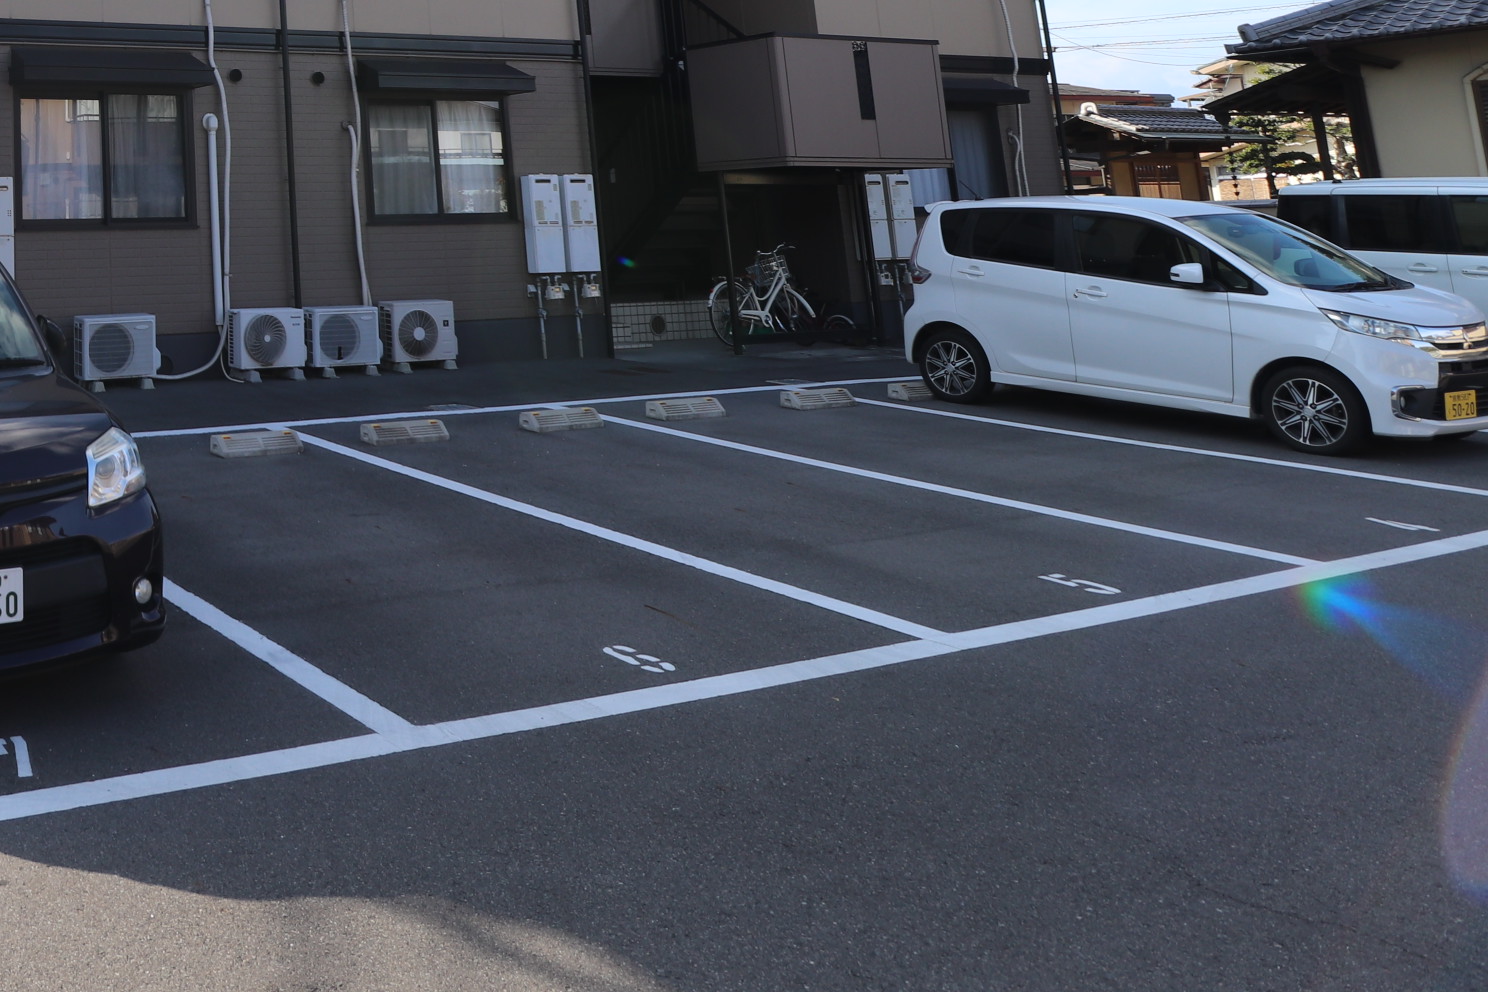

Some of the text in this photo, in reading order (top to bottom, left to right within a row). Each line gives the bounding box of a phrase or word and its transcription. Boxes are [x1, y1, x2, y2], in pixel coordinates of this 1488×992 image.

[1452, 401, 1475, 418] 50-20
[1036, 573, 1122, 596] 5
[602, 644, 676, 674] 6
